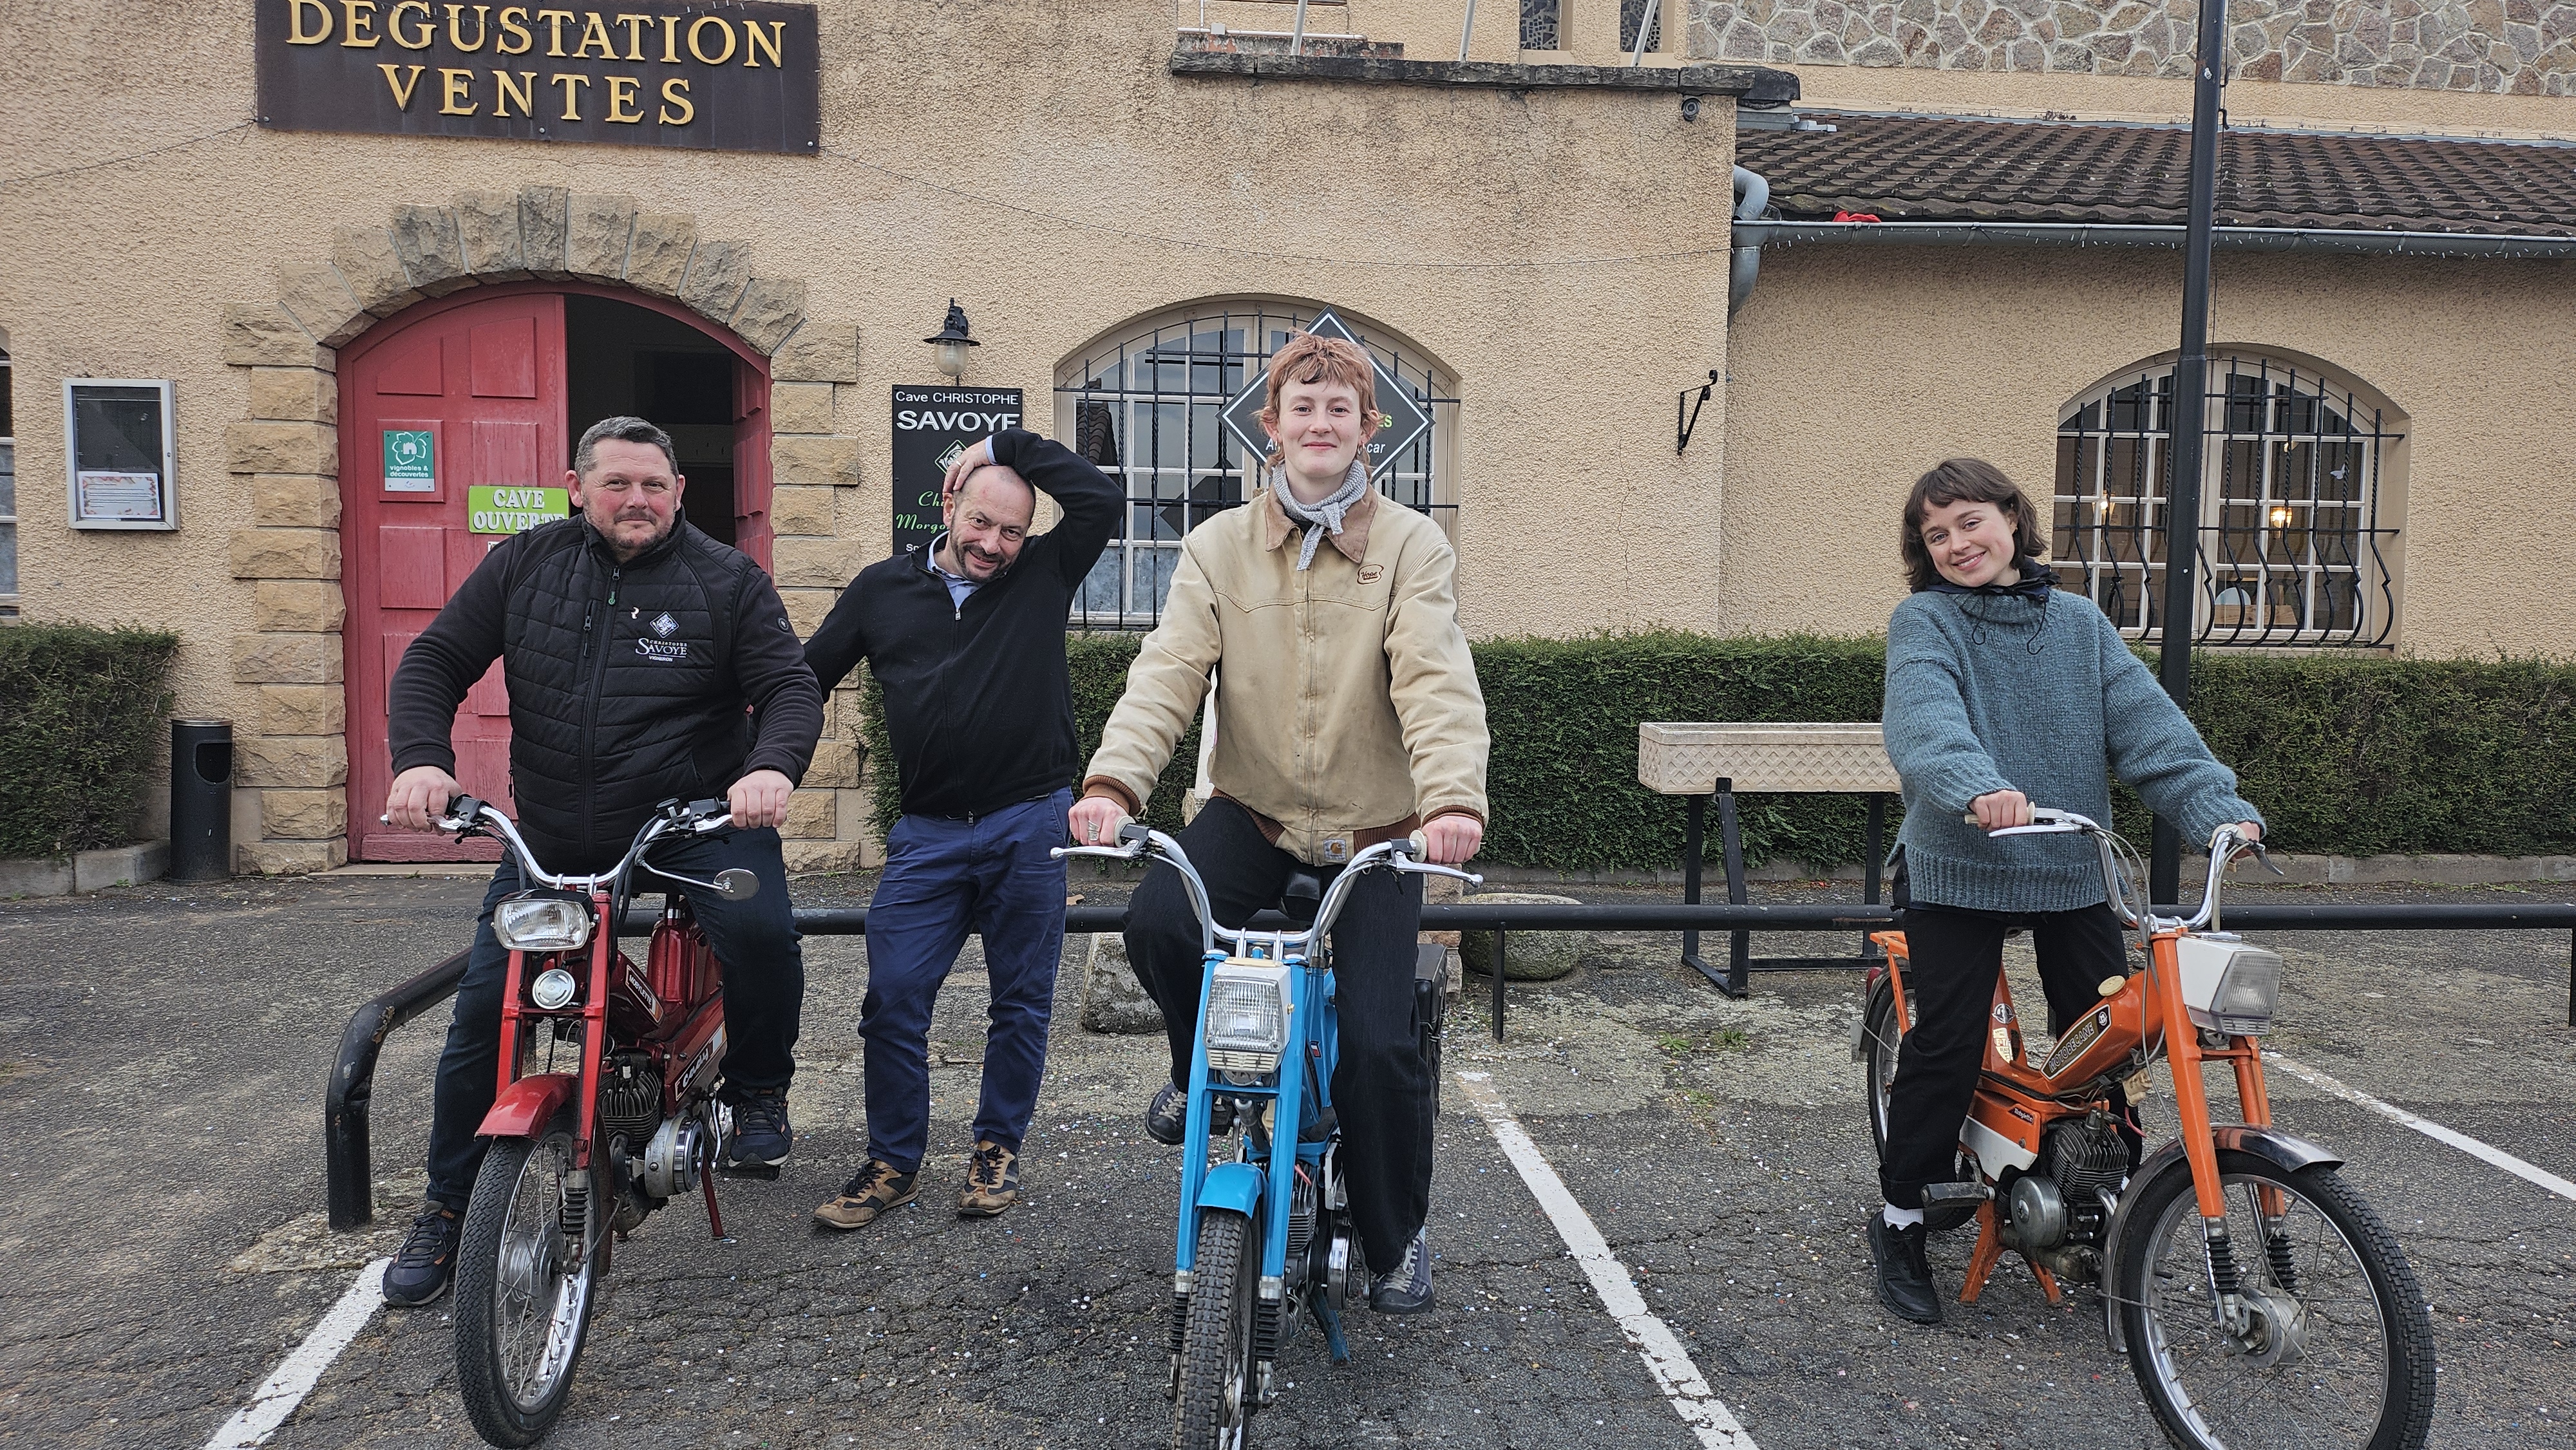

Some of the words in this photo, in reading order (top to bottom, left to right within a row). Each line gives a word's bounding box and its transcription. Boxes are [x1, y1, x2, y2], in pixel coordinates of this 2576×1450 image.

[377, 63, 696, 126] VENTES
[896, 391, 928, 402] Cave
[933, 392, 1019, 405] CHRISTOPHE
[493, 489, 545, 509] CAVE
[1360, 570, 1378, 580] Hope
[635, 637, 687, 655] SAVOYE
[629, 974, 652, 1005] MOBYLETTE
[2048, 1021, 2095, 1073] MOTOBECANE
